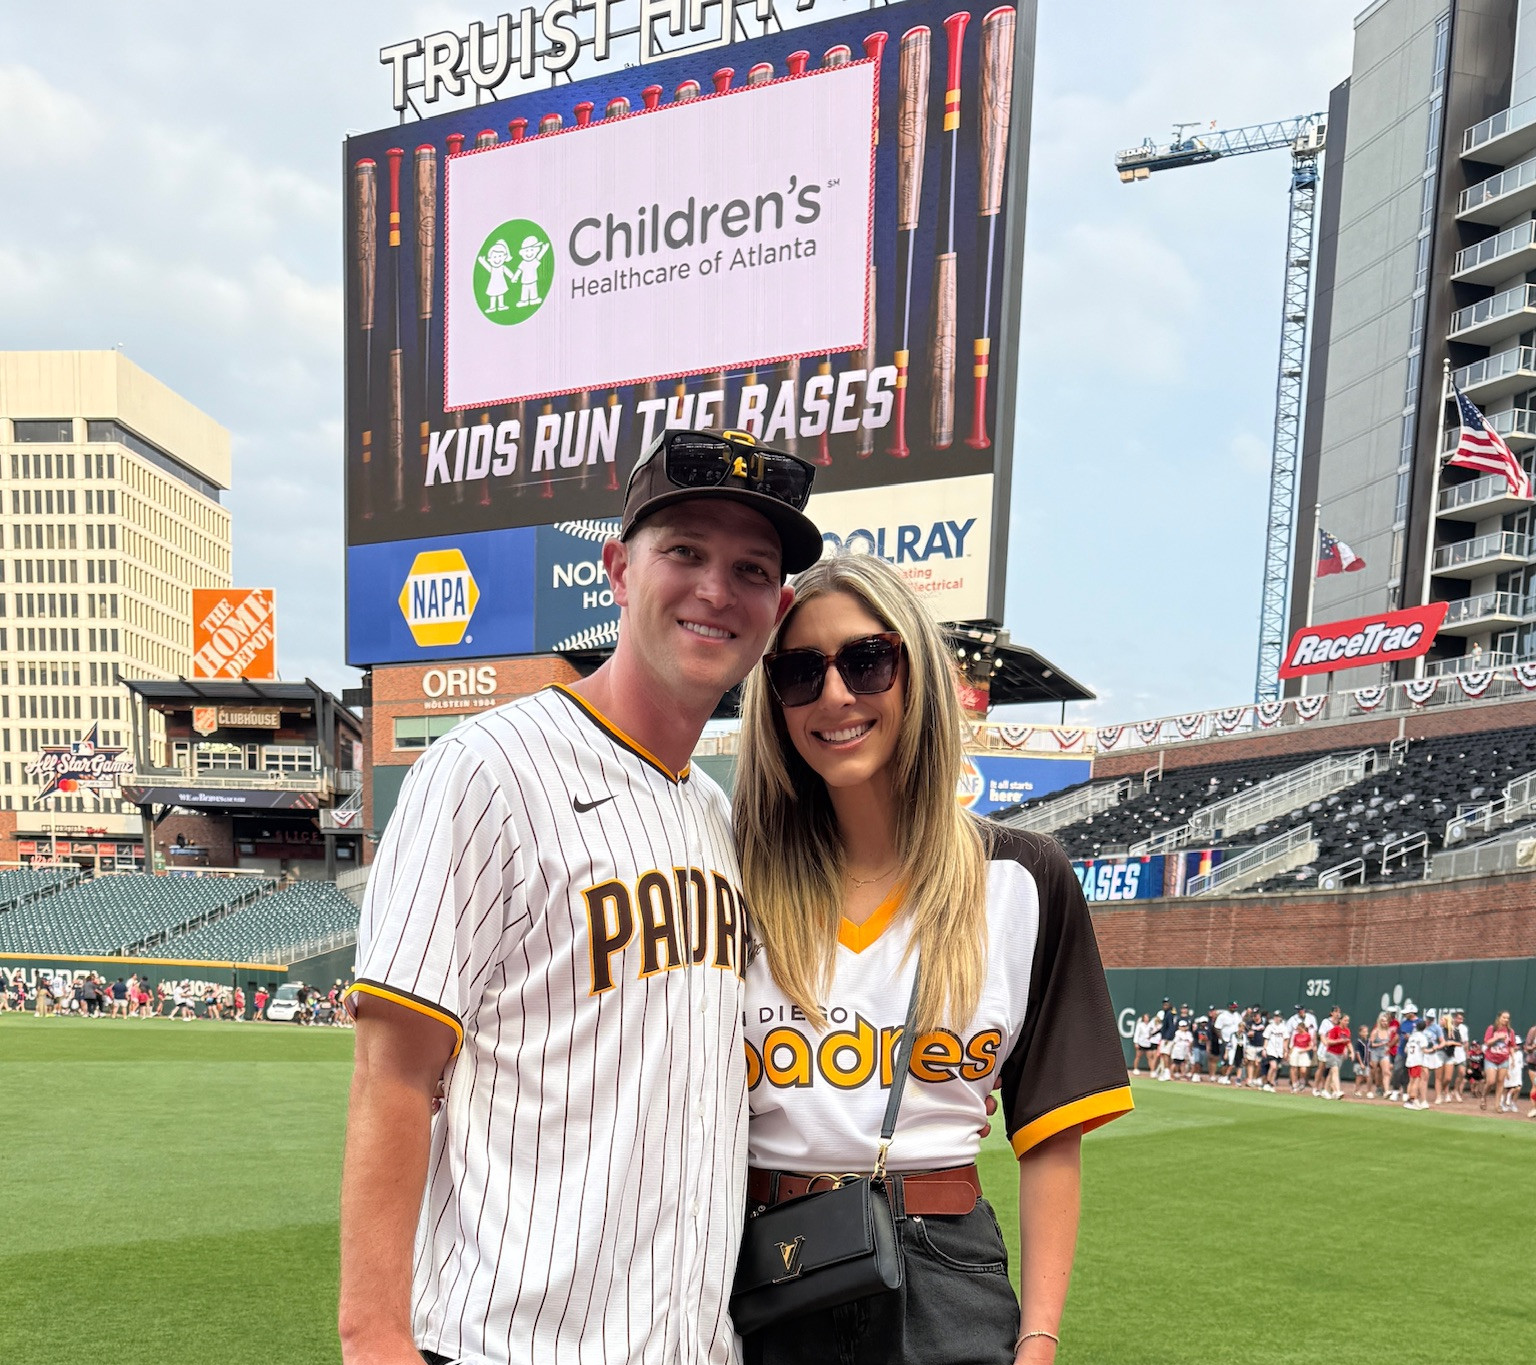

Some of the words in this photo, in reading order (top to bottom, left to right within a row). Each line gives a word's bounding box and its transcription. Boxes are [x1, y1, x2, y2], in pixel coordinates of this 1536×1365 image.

[379, 0, 610, 111] TRUIST
[569, 175, 821, 266] Children's
[571, 263, 690, 299] Healthcare
[699, 250, 723, 276] of
[729, 237, 816, 270] Atlanta
[424, 418, 520, 487] KIDS
[531, 404, 622, 472] RUN
[636, 390, 724, 449] THE
[737, 365, 899, 442] BASES
[200, 597, 235, 635] THE
[414, 577, 466, 619] NAPA
[583, 589, 614, 609] HO
[193, 589, 275, 679] HOME
[224, 622, 276, 679] DEPOT
[1290, 622, 1425, 668] RaceTrac
[422, 666, 498, 698] ORIS
[218, 711, 278, 726] CLUBHOUSE
[90, 754, 134, 776] Game
[990, 789, 1023, 802] here
[1306, 979, 1331, 997] 375
